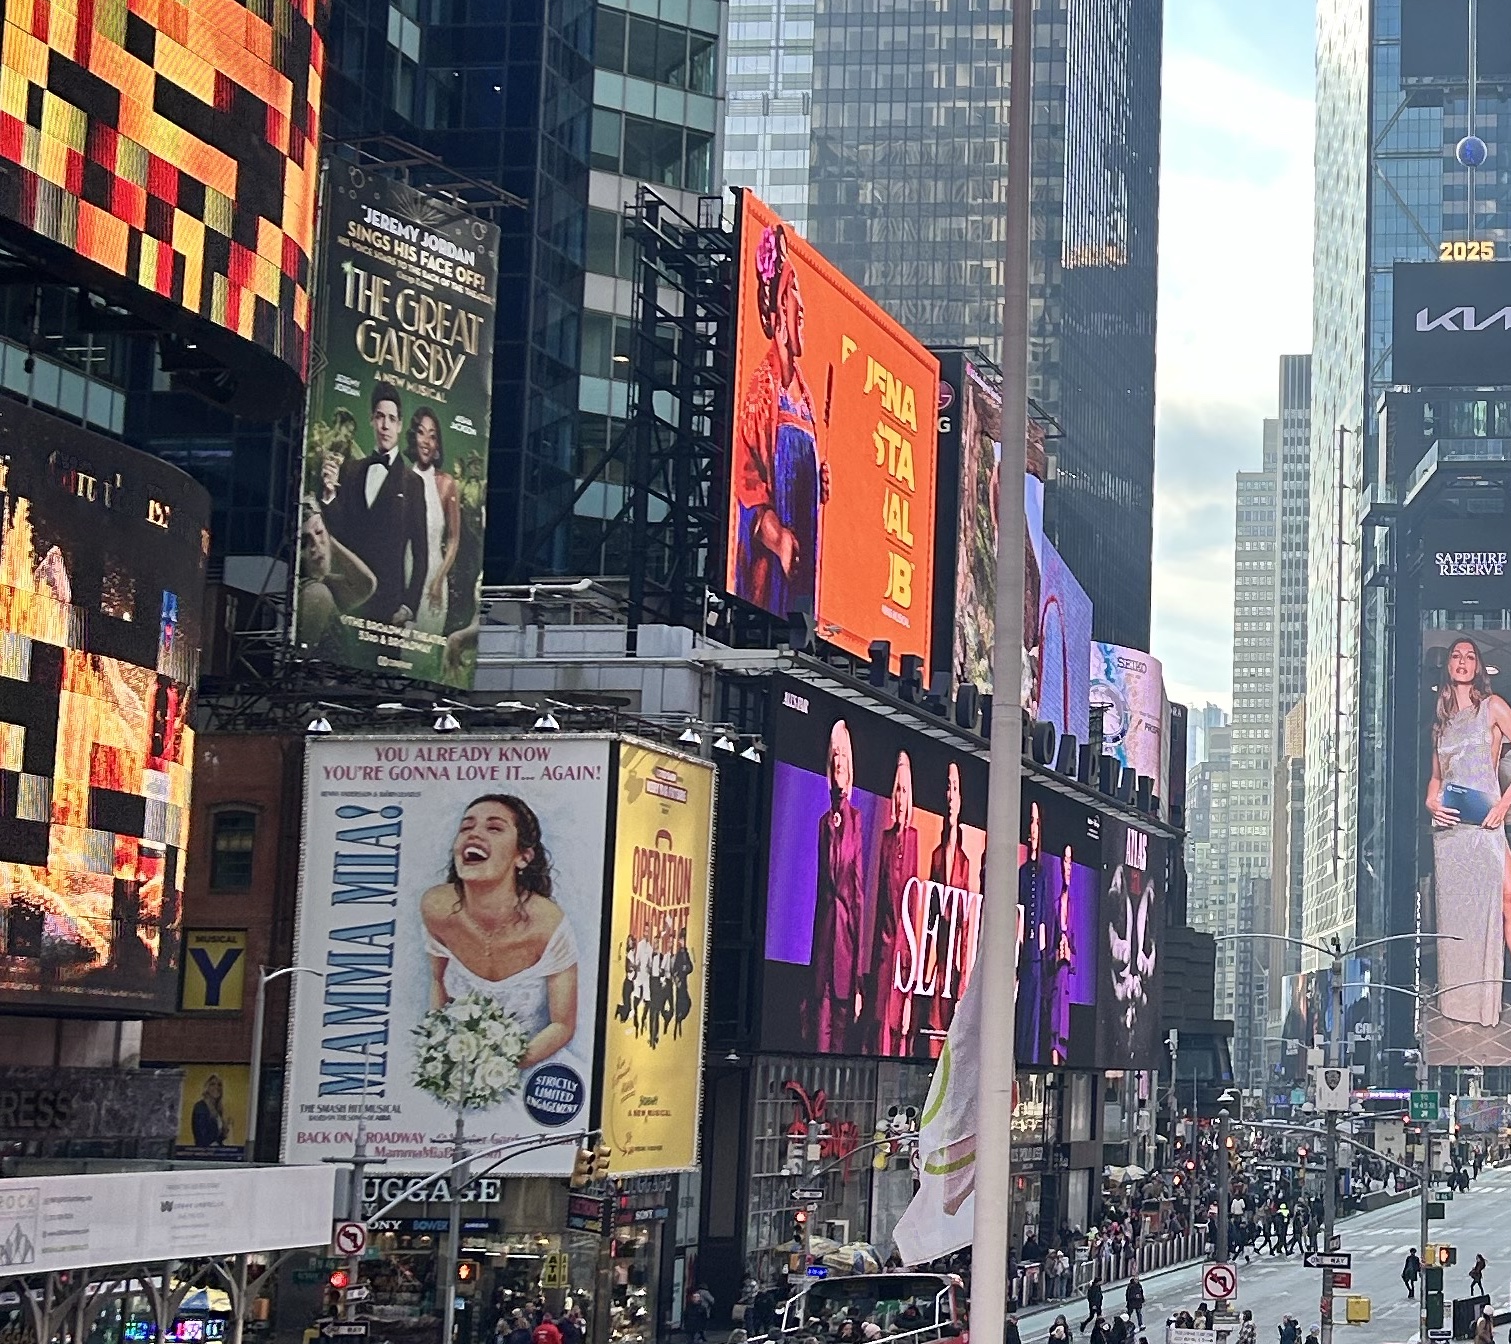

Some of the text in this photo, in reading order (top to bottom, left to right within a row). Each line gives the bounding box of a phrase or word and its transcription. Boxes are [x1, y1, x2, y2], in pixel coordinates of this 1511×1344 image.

[347, 220, 486, 291] SINGS HIS FACE OFF!
[421, 231, 476, 267] JORDAN
[1439, 241, 1495, 261] 2025
[341, 261, 392, 323] THE
[396, 288, 485, 356] GREAT
[355, 319, 466, 391] GATSBY
[373, 370, 447, 404] A NEW MUSICAL
[1435, 552, 1508, 565] SAPPHIRE
[1439, 563, 1504, 576] RESERVE
[1117, 657, 1147, 674] SEIKO
[375, 746, 552, 762] YOU ALREADY KNOW
[322, 765, 383, 780] YOU'RE
[389, 764, 450, 781] GONNA
[457, 764, 499, 781] LOVE
[540, 764, 602, 781] AGAIN!
[331, 804, 404, 907] MIA!
[632, 845, 693, 908] OPERATION
[188, 948, 245, 1007] Y
[318, 918, 397, 1098] MAMMA
[535, 1075, 578, 1091] STRICTLY
[534, 1085, 574, 1103] LIMITED
[299, 1103, 402, 1114] THE SMASH HIT MUSICAL
[526, 1095, 579, 1115] ENGAGEMENT
[296, 1131, 353, 1145] BACK ON
[362, 1178, 501, 1203] UGGAGE
